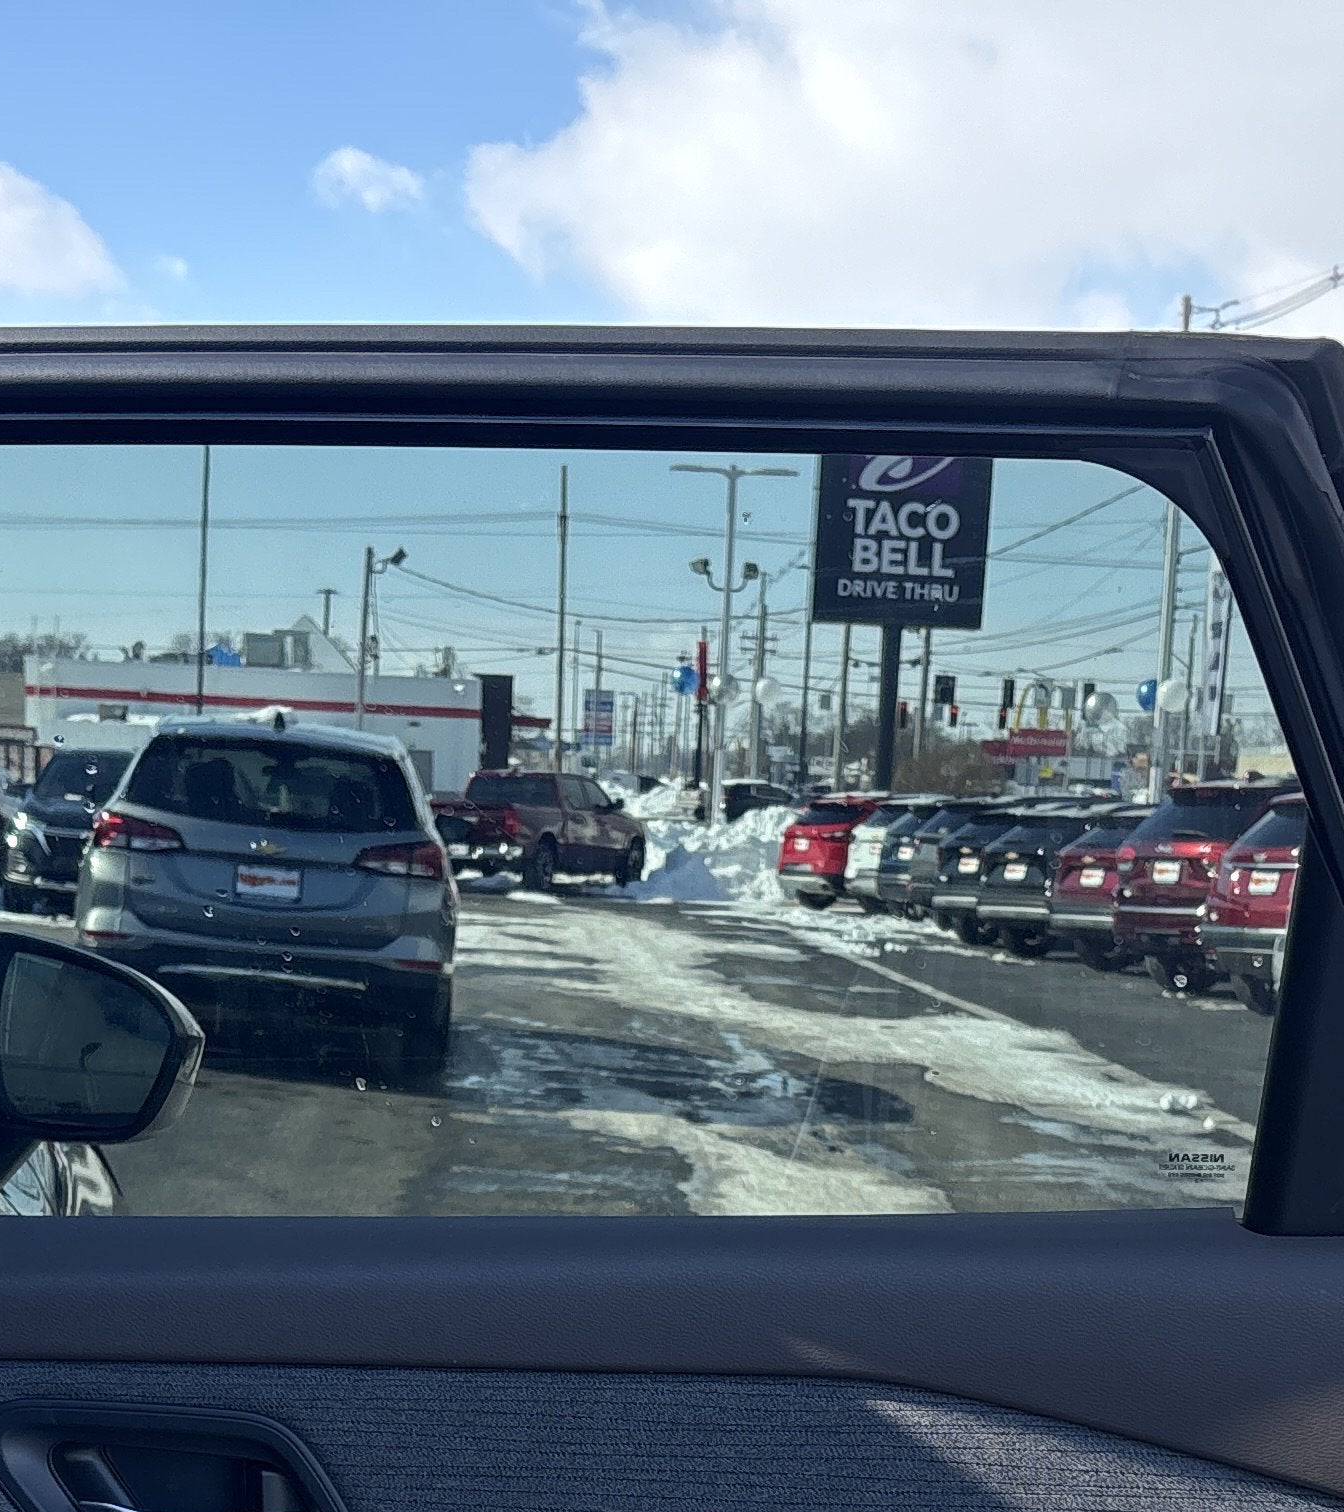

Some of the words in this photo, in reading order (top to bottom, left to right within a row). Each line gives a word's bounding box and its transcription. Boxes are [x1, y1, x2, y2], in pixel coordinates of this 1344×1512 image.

[847, 498, 961, 540] TACO
[852, 538, 955, 579] BELL
[837, 578, 899, 599] DRIVE
[902, 582, 960, 603] THRU
